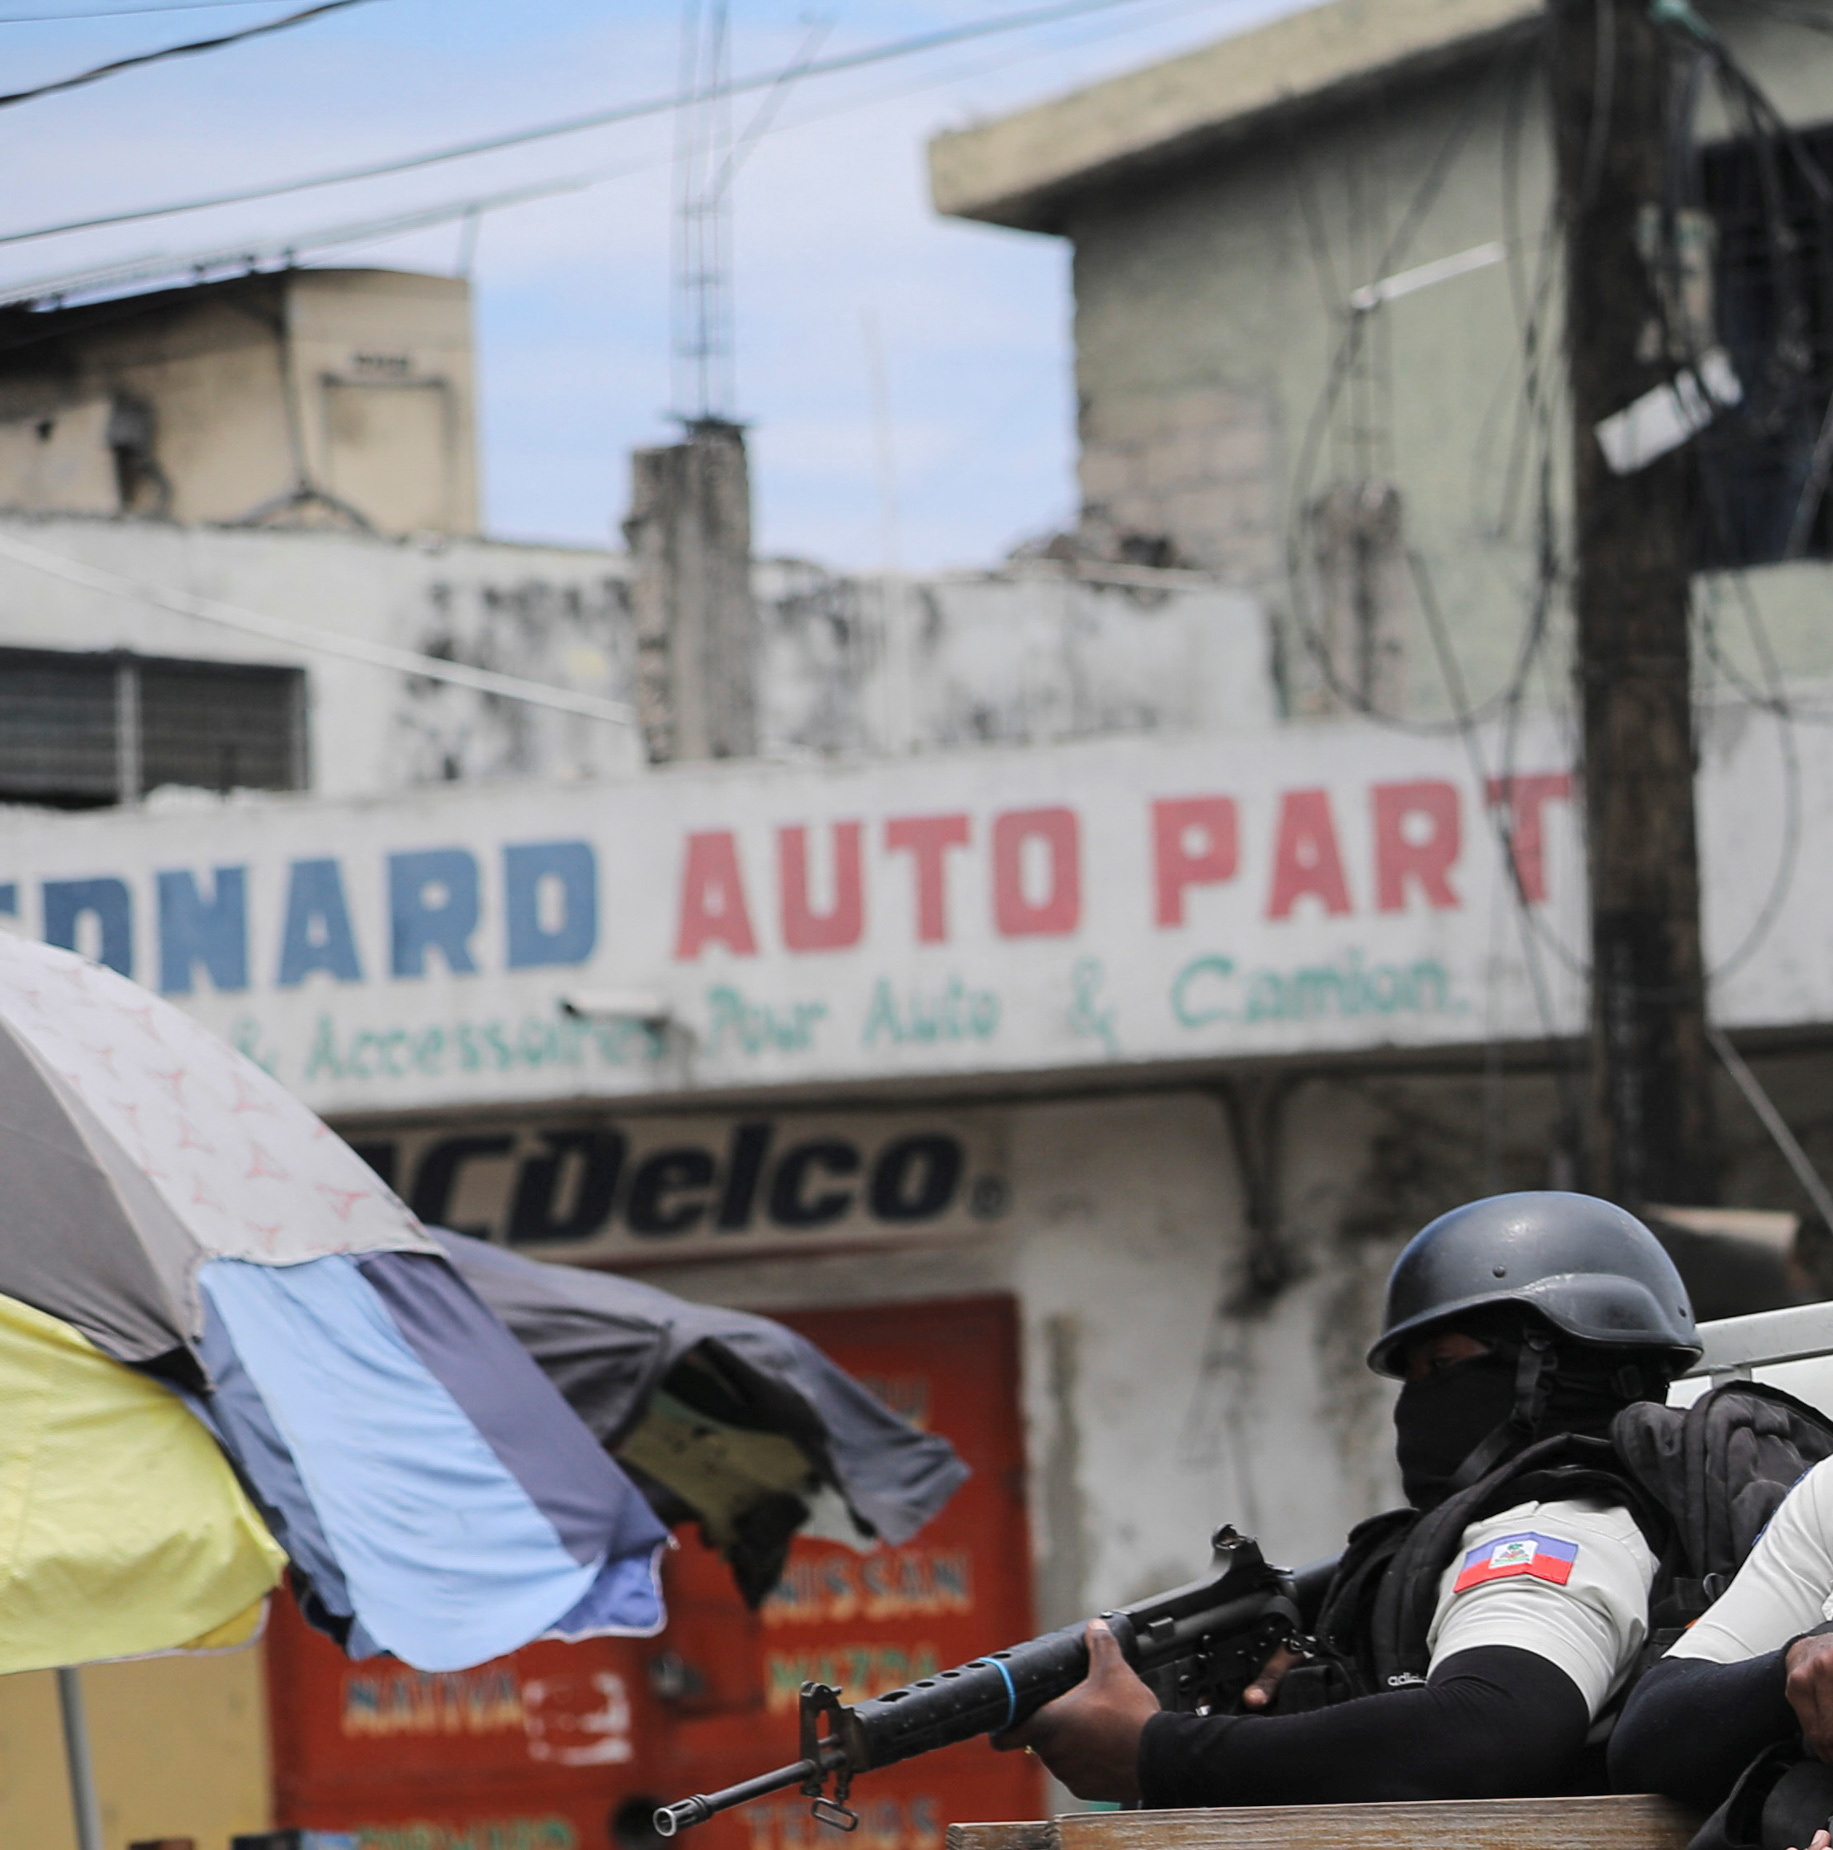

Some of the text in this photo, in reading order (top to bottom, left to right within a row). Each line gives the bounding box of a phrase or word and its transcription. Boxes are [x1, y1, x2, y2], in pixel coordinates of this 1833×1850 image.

[673, 805, 1082, 962] AUTO
[701, 984, 828, 1058] Pour
[860, 975, 999, 1050] Auto
[1069, 955, 1122, 1055] &
[350, 1120, 965, 1247] CDelco
